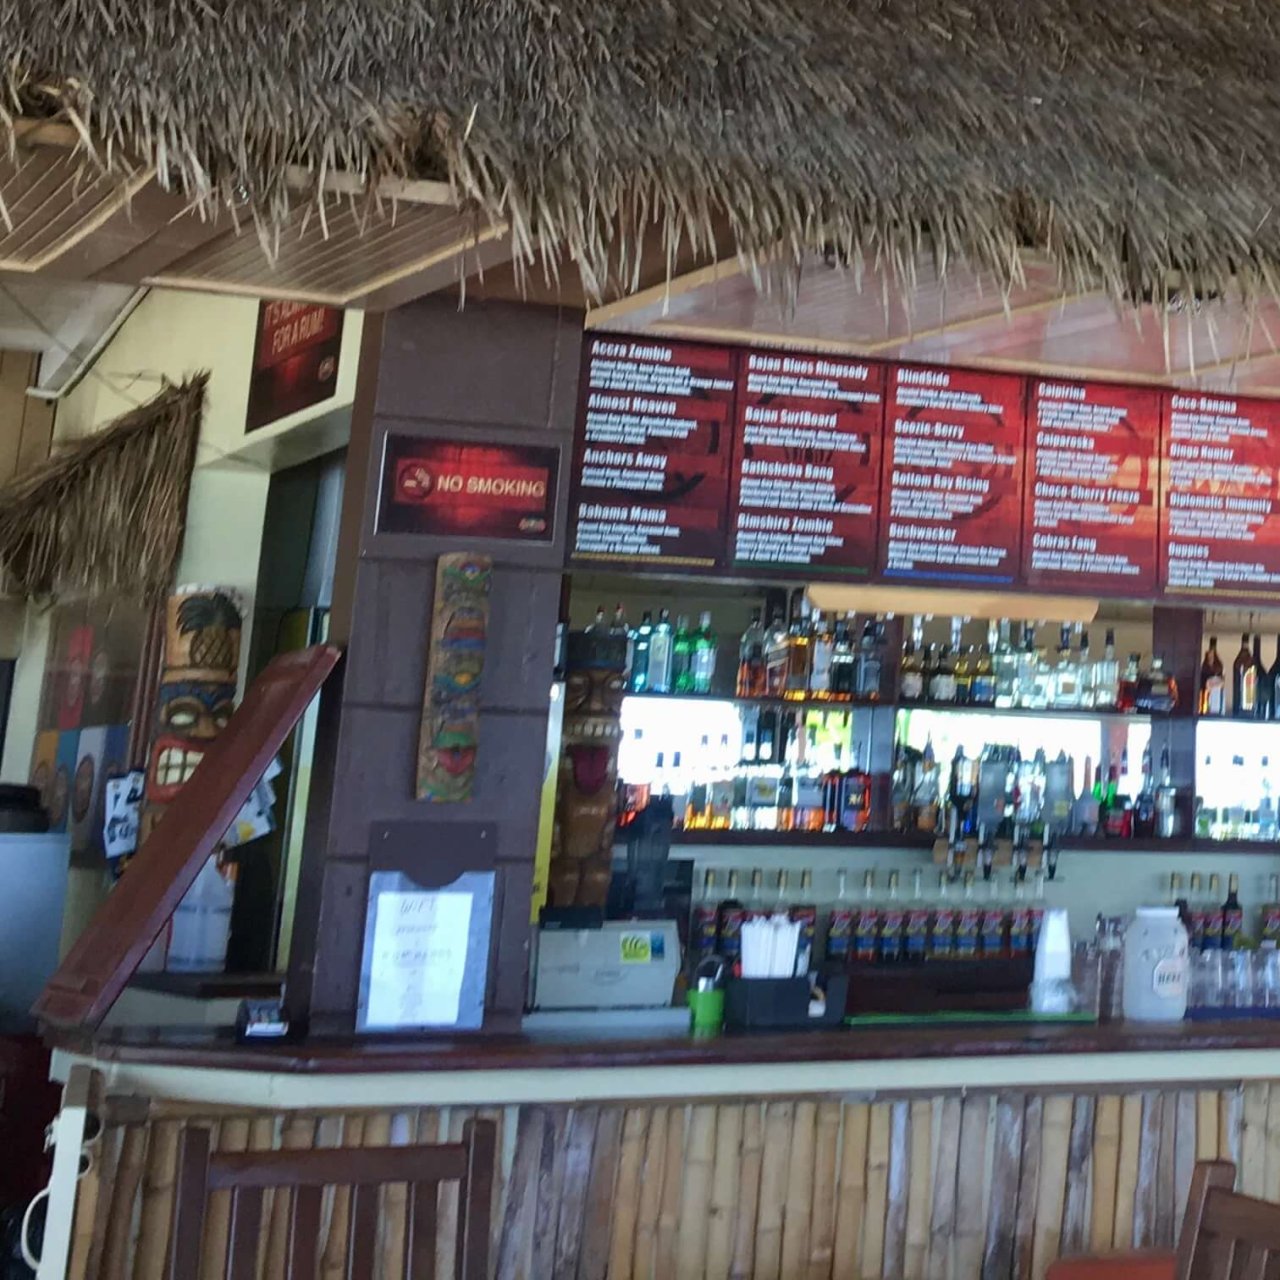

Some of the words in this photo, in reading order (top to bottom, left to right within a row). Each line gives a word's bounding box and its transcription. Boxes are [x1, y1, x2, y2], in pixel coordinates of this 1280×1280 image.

[628, 343, 672, 362] Zombie
[782, 357, 814, 375] Blues
[815, 360, 868, 381] Rhapsody
[587, 393, 630, 410] Almost
[632, 397, 677, 415] Heaven
[583, 447, 633, 466] Anchors
[635, 451, 668, 470] Away
[437, 474, 463, 493] NO
[466, 476, 545, 497] SMOKING
[892, 470, 932, 488] Bottom
[955, 475, 990, 494] Rising
[578, 502, 629, 520] Bahama
[630, 505, 666, 524] Mama
[1225, 495, 1272, 514] Immunity
[792, 515, 833, 534] Zombie
